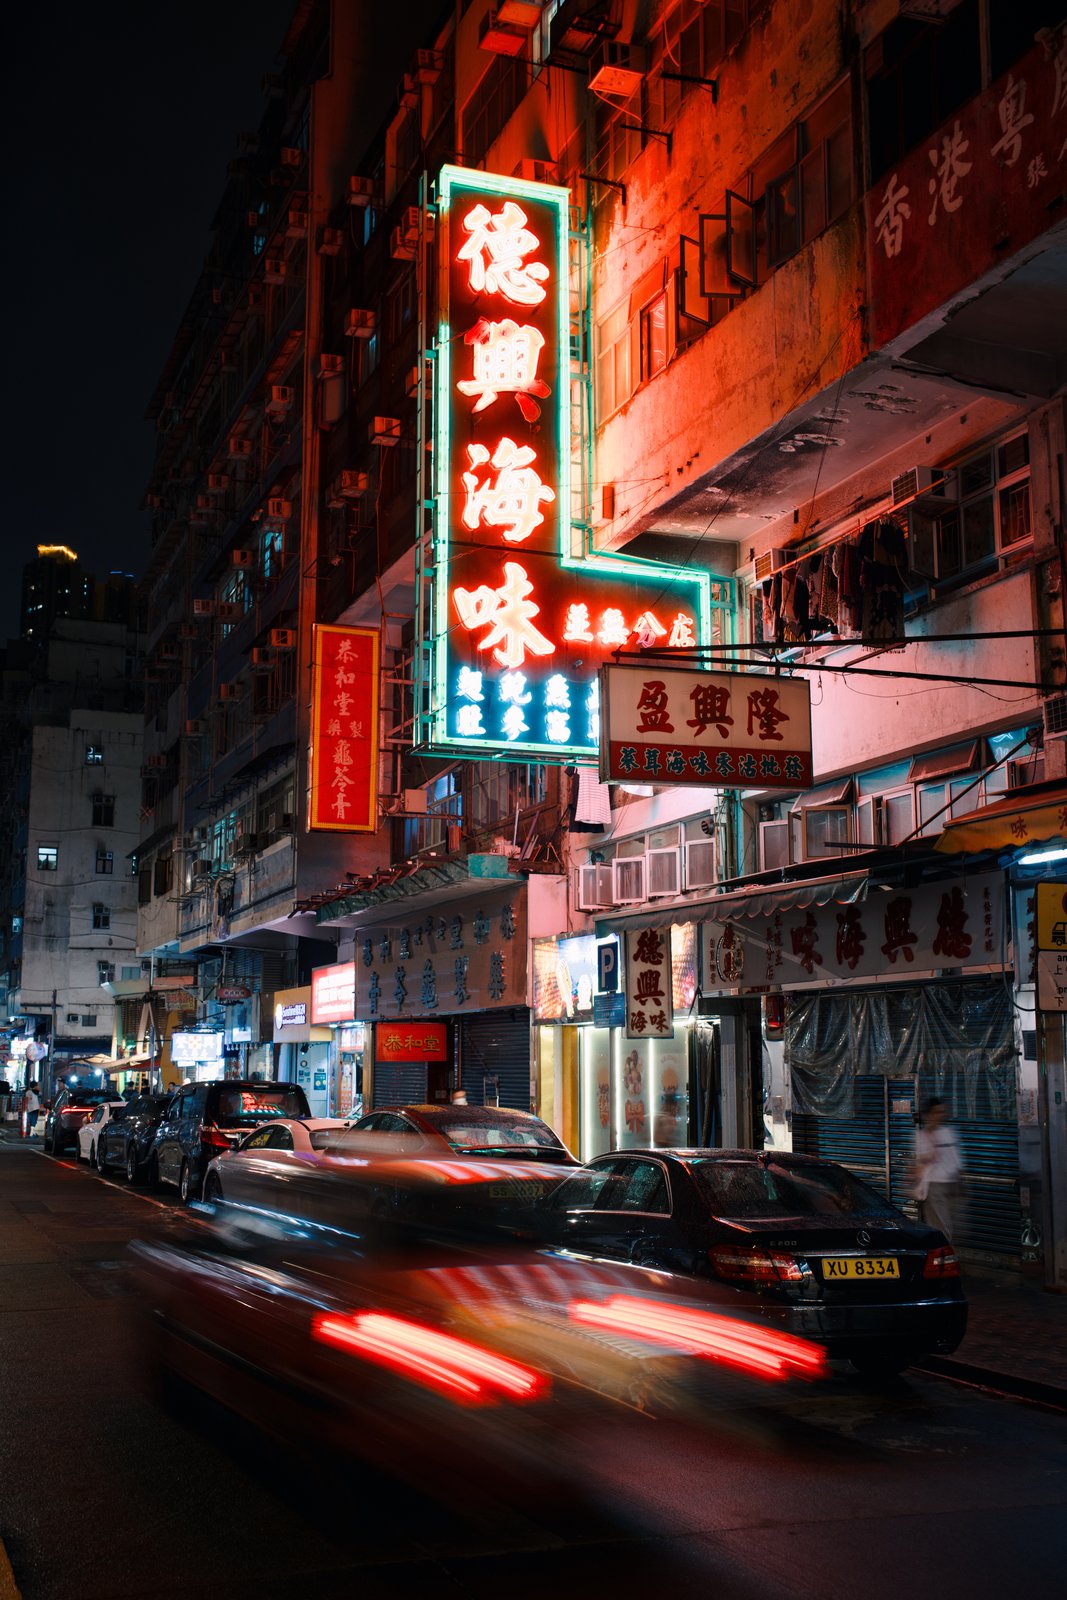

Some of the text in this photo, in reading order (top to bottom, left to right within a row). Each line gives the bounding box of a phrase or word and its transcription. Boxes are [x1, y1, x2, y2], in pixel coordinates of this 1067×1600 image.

[452, 200, 557, 670] 德興海味
[562, 602, 697, 648] 並無分店
[635, 680, 790, 741] 盈興隆
[601, 947, 615, 989] P
[632, 928, 665, 1007] 德興
[384, 1033, 441, 1054] 恭和堂
[630, 1010, 669, 1033] 海味
[827, 1260, 896, 1277] XU 8334
